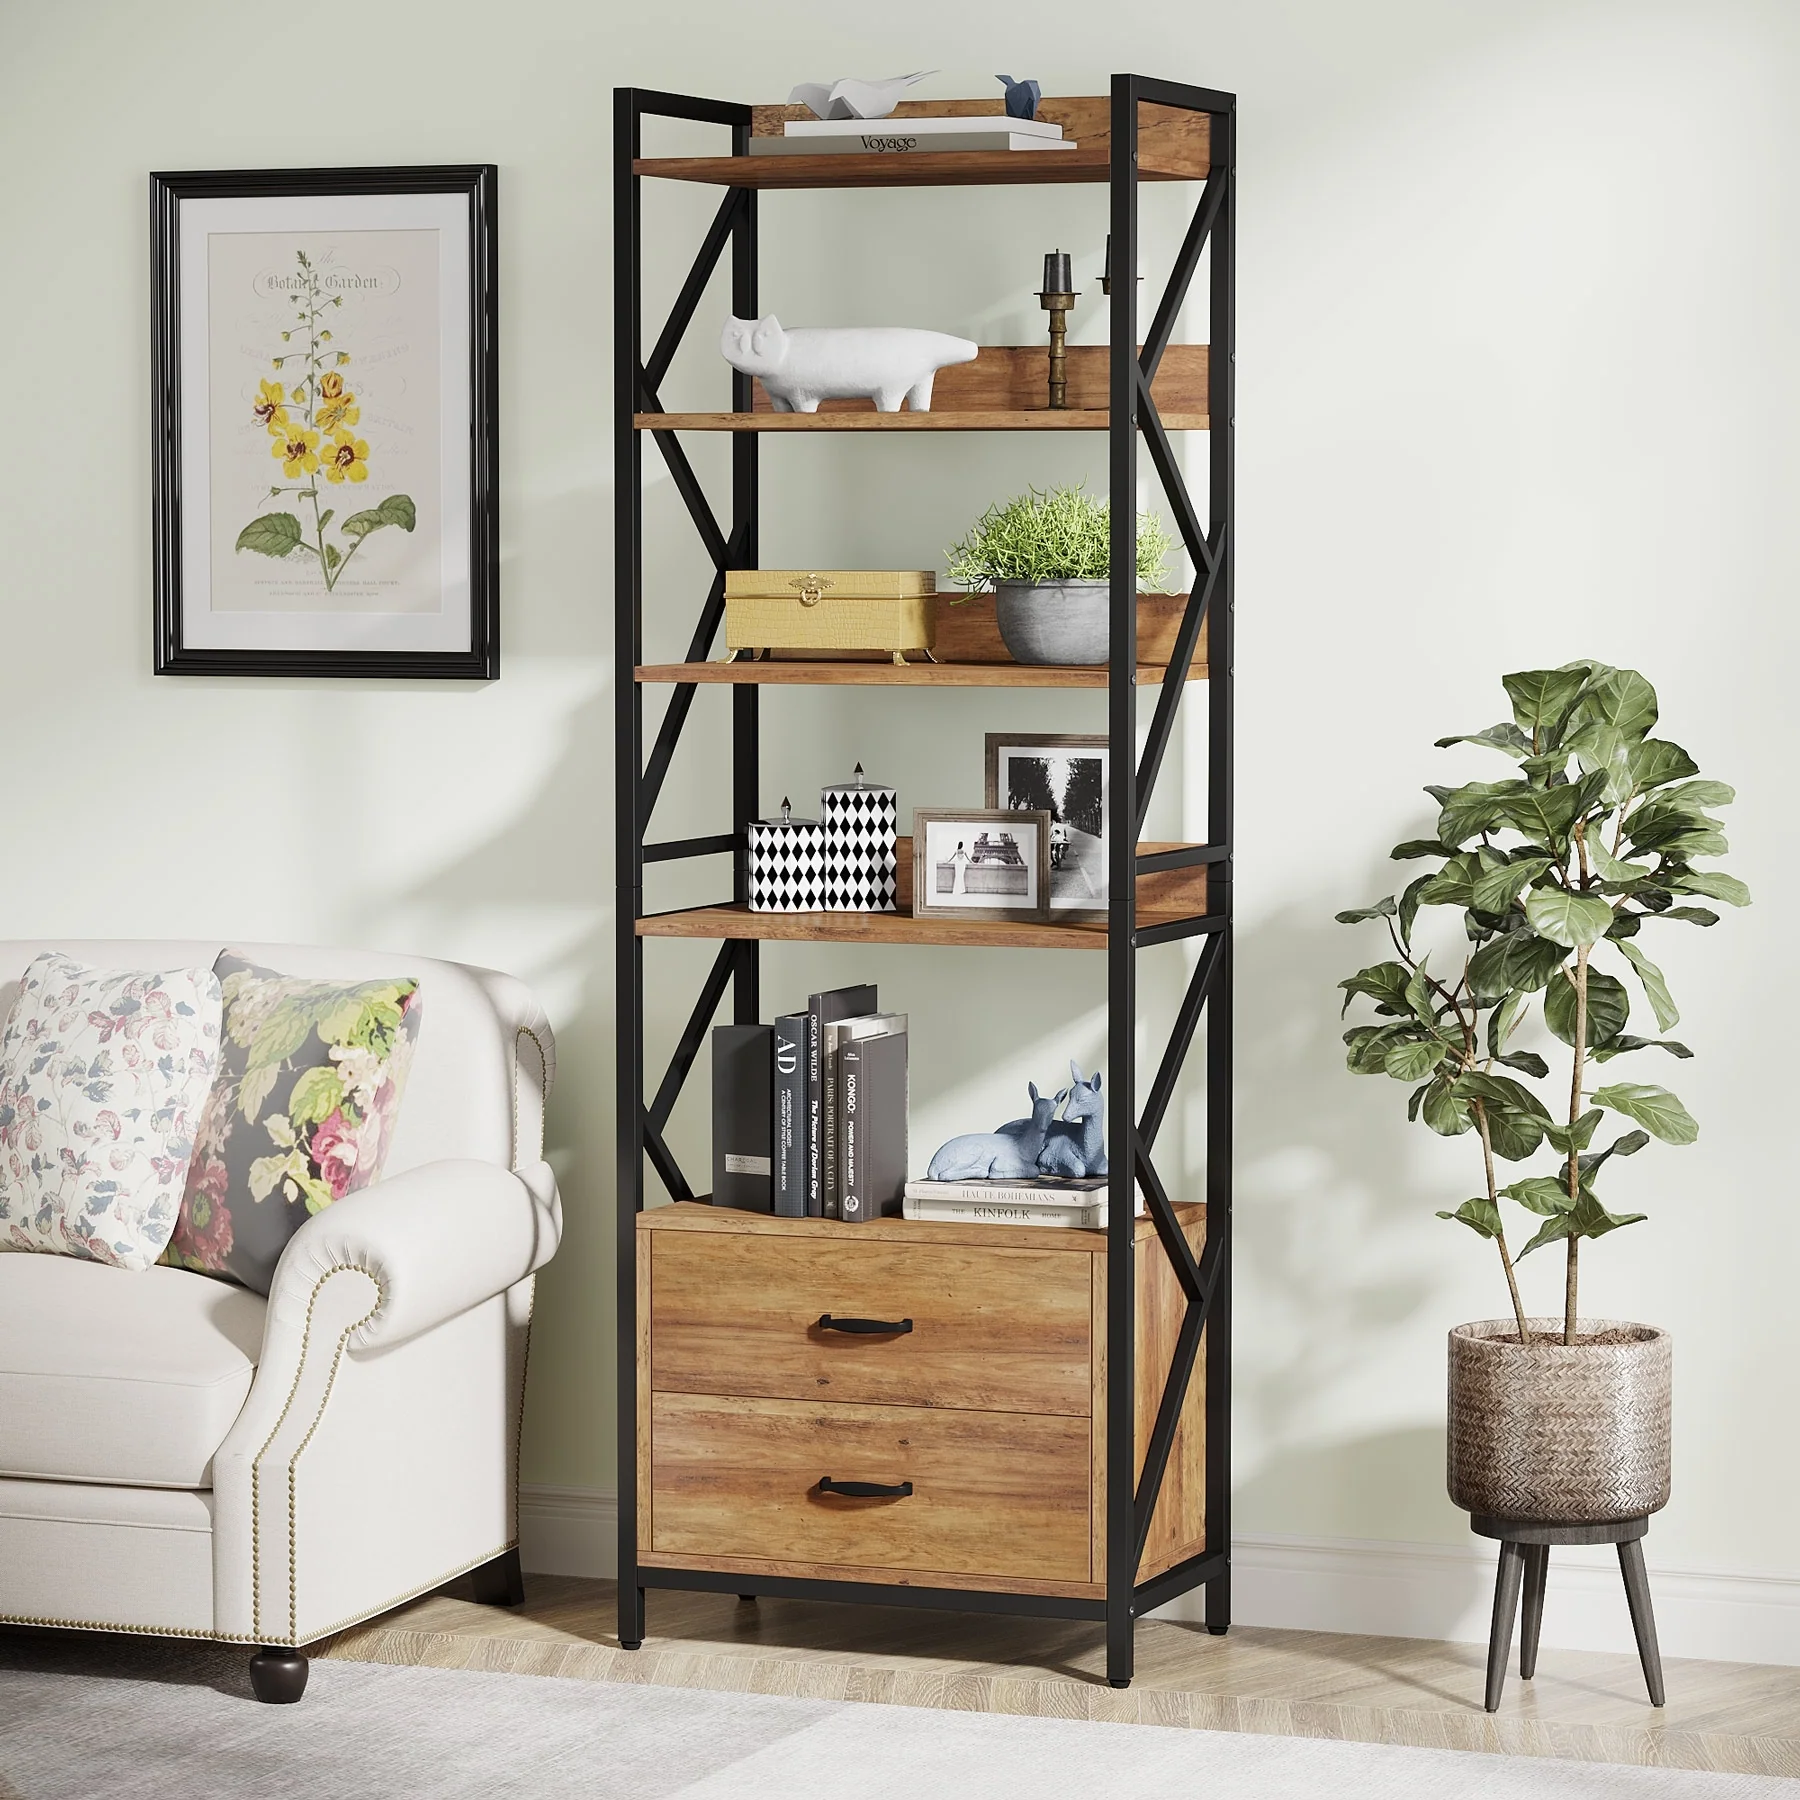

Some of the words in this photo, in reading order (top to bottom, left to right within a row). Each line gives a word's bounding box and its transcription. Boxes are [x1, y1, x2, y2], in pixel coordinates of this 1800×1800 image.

[861, 135, 917, 152] Voyage
[267, 274, 319, 289] Botan
[777, 1035, 796, 1074] AD
[847, 1074, 856, 1114] KONGO:
[781, 1118, 786, 1126] OF
[810, 1143, 818, 1153] of
[827, 1150, 834, 1162] OF
[810, 1180, 818, 1199] Gray
[962, 1190, 993, 1199] HAUTE
[998, 1191, 1055, 1201] BOHEMIANS
[974, 1207, 1031, 1220] KINFOLK
